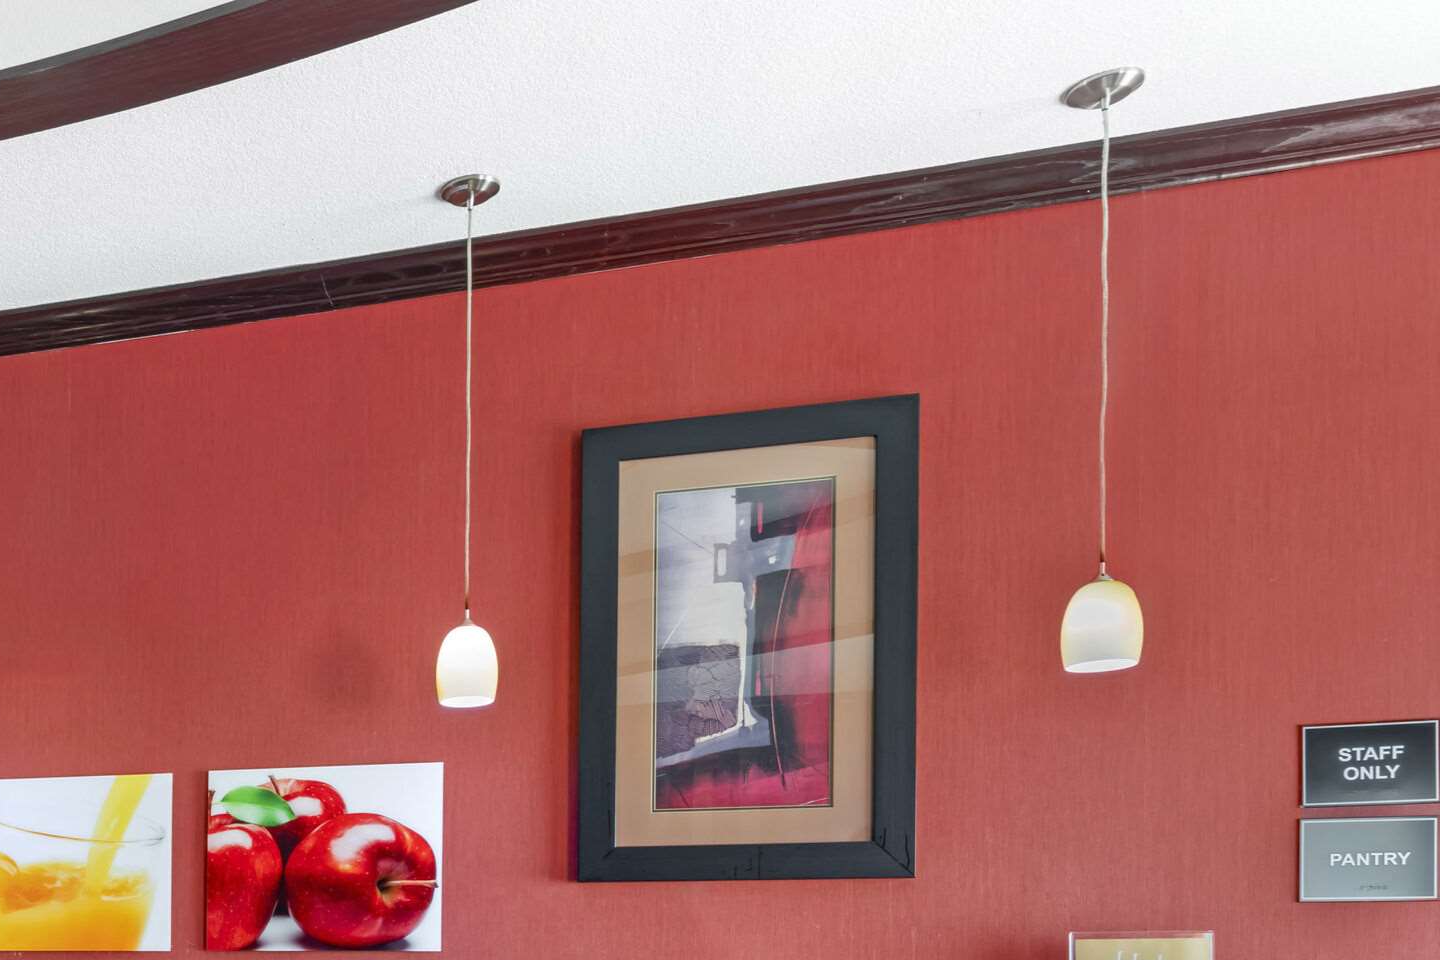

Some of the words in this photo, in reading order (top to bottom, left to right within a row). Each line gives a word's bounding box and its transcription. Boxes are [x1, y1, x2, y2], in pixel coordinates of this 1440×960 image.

[1338, 745, 1404, 762] STAFF
[1343, 764, 1400, 781] ONLY
[1329, 852, 1411, 866] PANTRY
